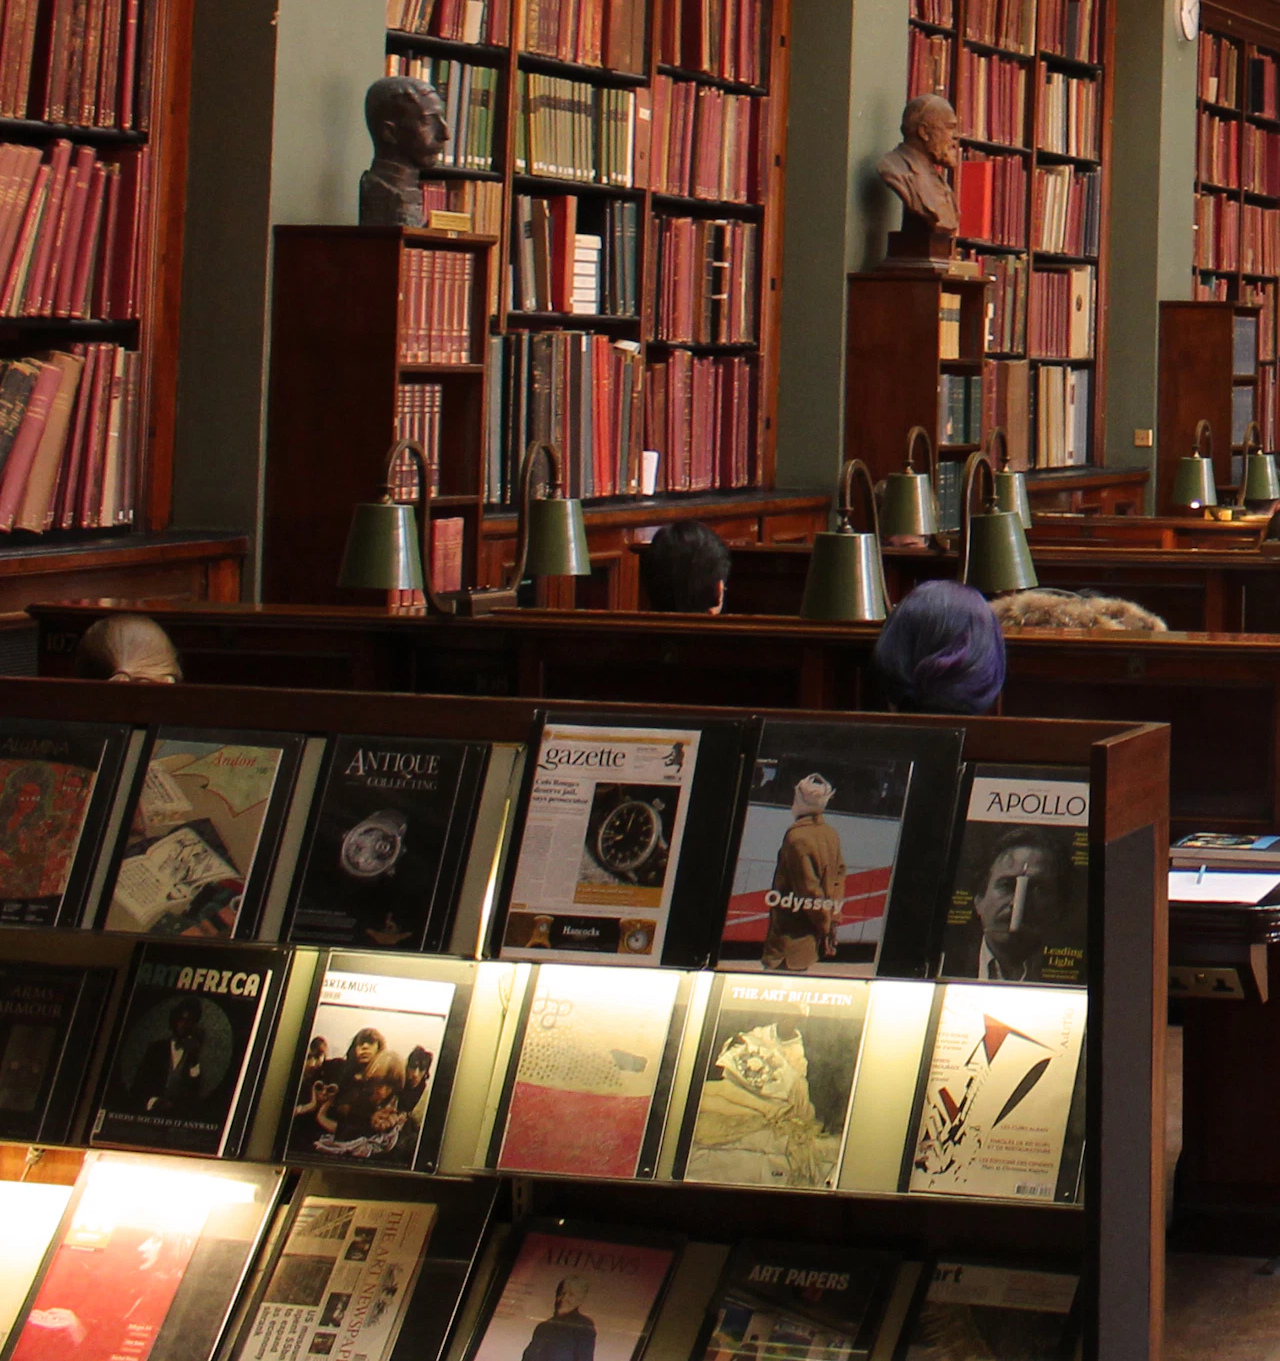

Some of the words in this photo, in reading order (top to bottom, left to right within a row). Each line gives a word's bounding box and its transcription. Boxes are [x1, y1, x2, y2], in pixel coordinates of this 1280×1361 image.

[344, 748, 440, 779] ANTIQUE
[538, 747, 626, 770] gazette
[367, 776, 438, 790] COLLECTING
[986, 792, 1086, 817] APOLLO
[764, 890, 845, 915] Odyssey
[562, 925, 600, 936] Hancocks
[1043, 946, 1083, 959] Leading
[1048, 955, 1075, 968] Light
[731, 986, 759, 1000] THE
[759, 988, 787, 1002] ART
[787, 990, 853, 1006] BULLETIN
[382, 1210, 405, 1243] THE
[368, 1248, 389, 1278] ART
[547, 1247, 640, 1276] ARTNEWS
[749, 1264, 785, 1284] ART
[784, 1268, 850, 1290] PAPERS
[304, 1310, 317, 1323] US
[336, 1283, 376, 1361] NEWSPAP
